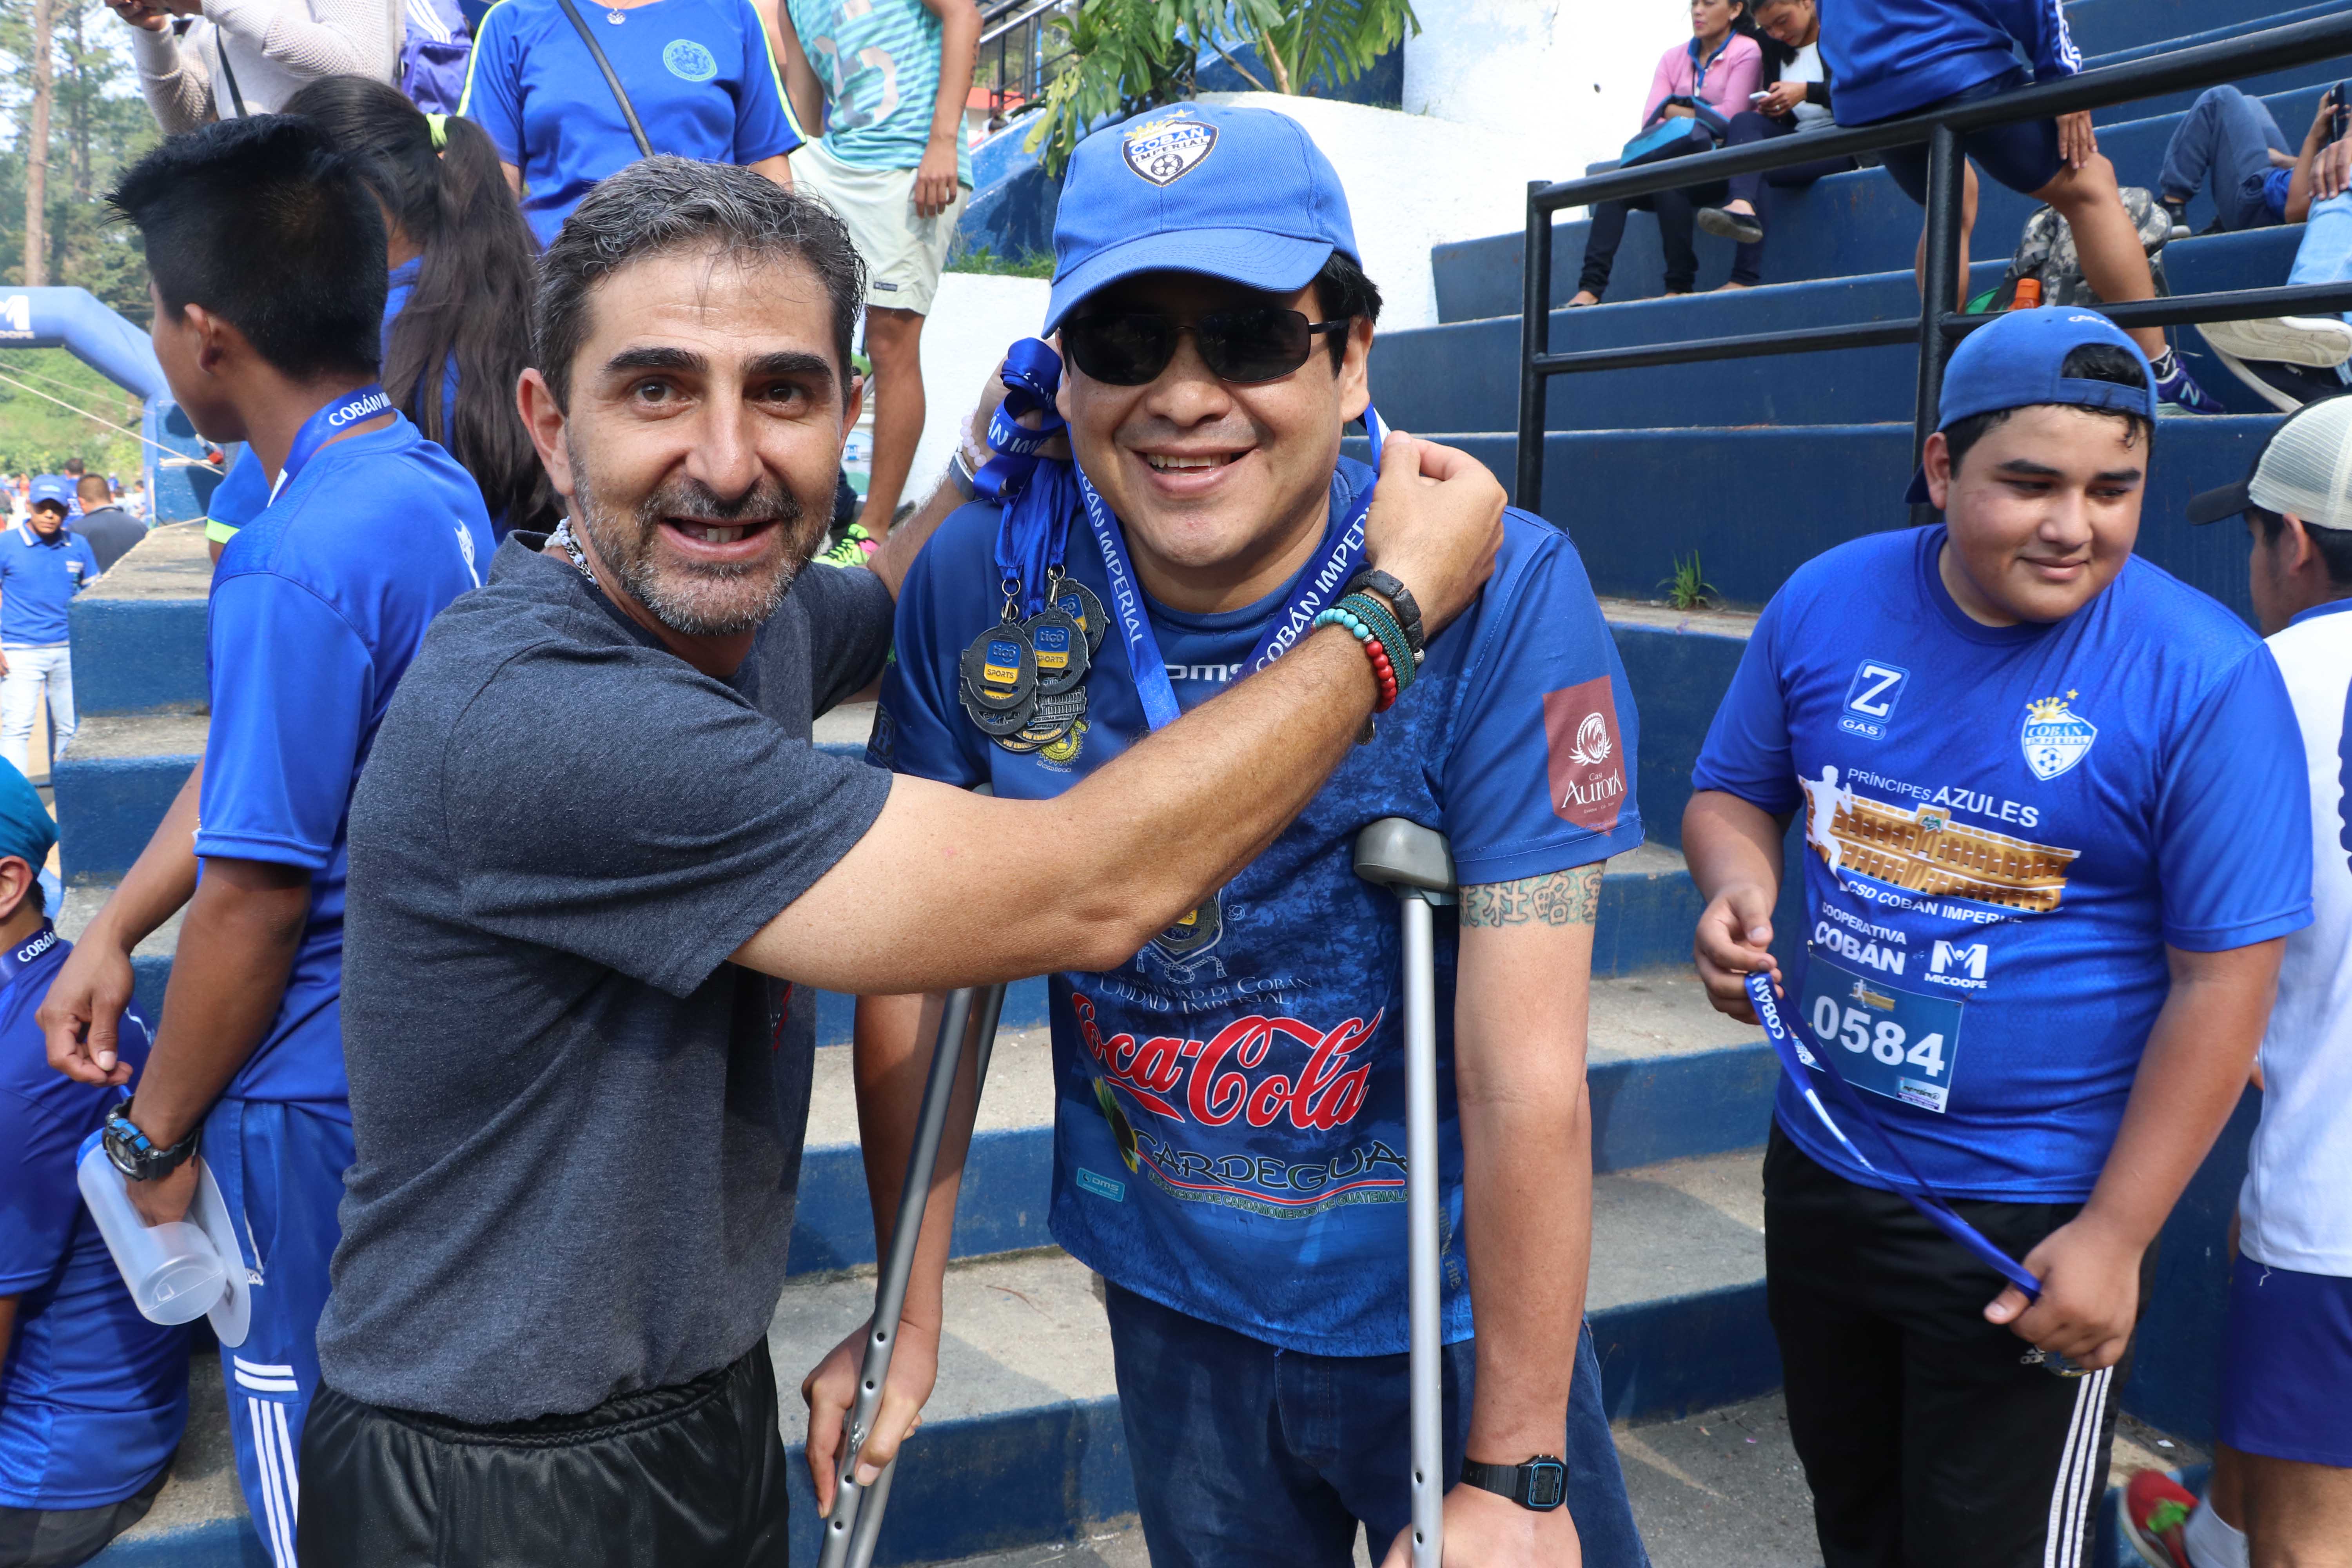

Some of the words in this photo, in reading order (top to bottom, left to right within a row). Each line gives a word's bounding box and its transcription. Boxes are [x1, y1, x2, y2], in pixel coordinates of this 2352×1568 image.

[1131, 127, 1205, 155] COBAN
[1136, 138, 1208, 162] IMPERIAL
[329, 394, 382, 426] COBÁN
[1099, 530, 1143, 651] IMPERIAL
[987, 668, 1014, 679] SPORTS
[1851, 665, 1902, 717] Z
[1843, 720, 1878, 735] GAS
[2027, 723, 2084, 737] COBÁN
[1847, 768, 1932, 800] PRÍNCIPES
[1932, 786, 2039, 828] AZULES
[1847, 880, 1877, 899] CSD
[1878, 891, 1938, 916] COBÁN
[1822, 902, 1907, 945] COOPERATIVA
[1815, 921, 1906, 975] COBÁN
[1924, 973, 1987, 989] MICOOPE
[1752, 977, 1784, 1040] COBÁN
[1813, 995, 1945, 1077] 0584
[1072, 992, 1384, 1131] Coca-Cola
[1205, 1192, 1222, 1205] DE
[1223, 1194, 1318, 1220] CARDAMOMEROS
[1319, 1200, 1336, 1212] DE
[1337, 1189, 1407, 1205] GUATEMALA
